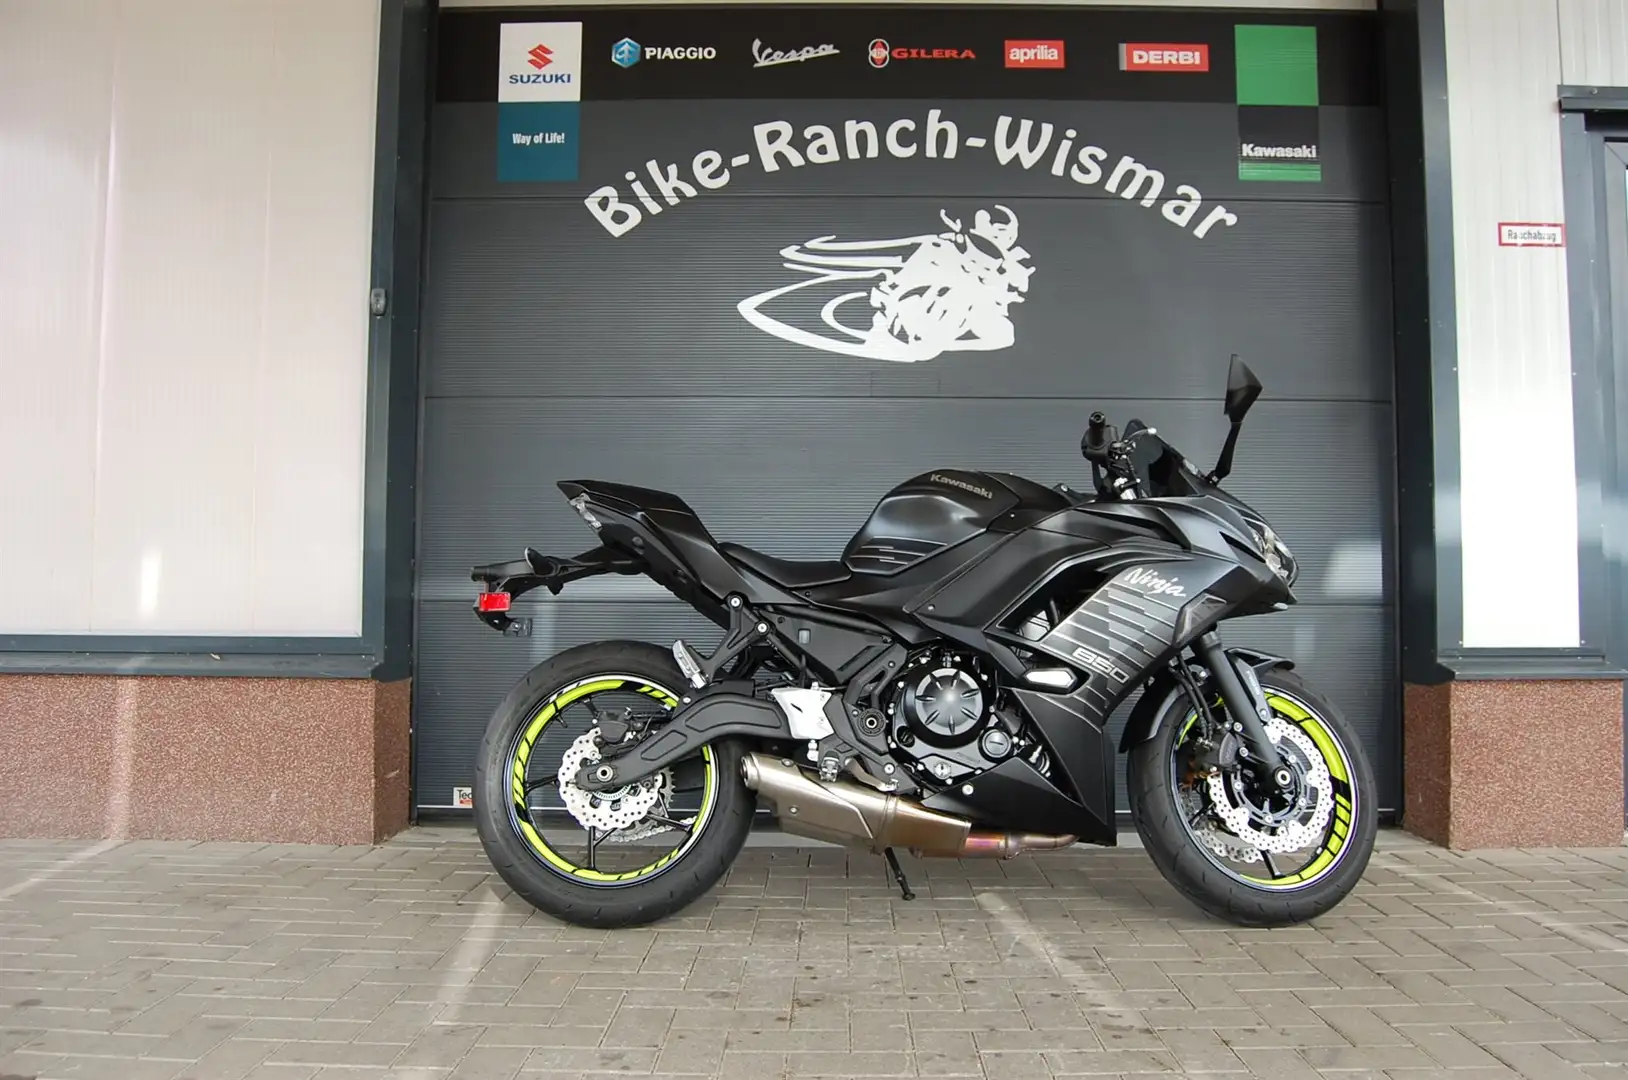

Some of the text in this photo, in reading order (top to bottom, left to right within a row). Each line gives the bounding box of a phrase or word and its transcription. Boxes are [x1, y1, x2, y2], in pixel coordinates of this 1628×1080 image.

[645, 46, 717, 61] PIAGGIO
[752, 38, 841, 68] Vespa
[891, 47, 976, 60] GILERA
[1008, 45, 1058, 62] aprilia
[1132, 50, 1201, 66] DERBI
[508, 73, 572, 85] SUZUKI
[512, 132, 565, 146] Way of Life!
[1241, 143, 1317, 159] Kawasaki
[584, 109, 1238, 239] Bike-Ranch-Wismar
[929, 473, 993, 499] Kawasaki
[1124, 567, 1187, 598] Ninja
[1072, 649, 1130, 684] 650
